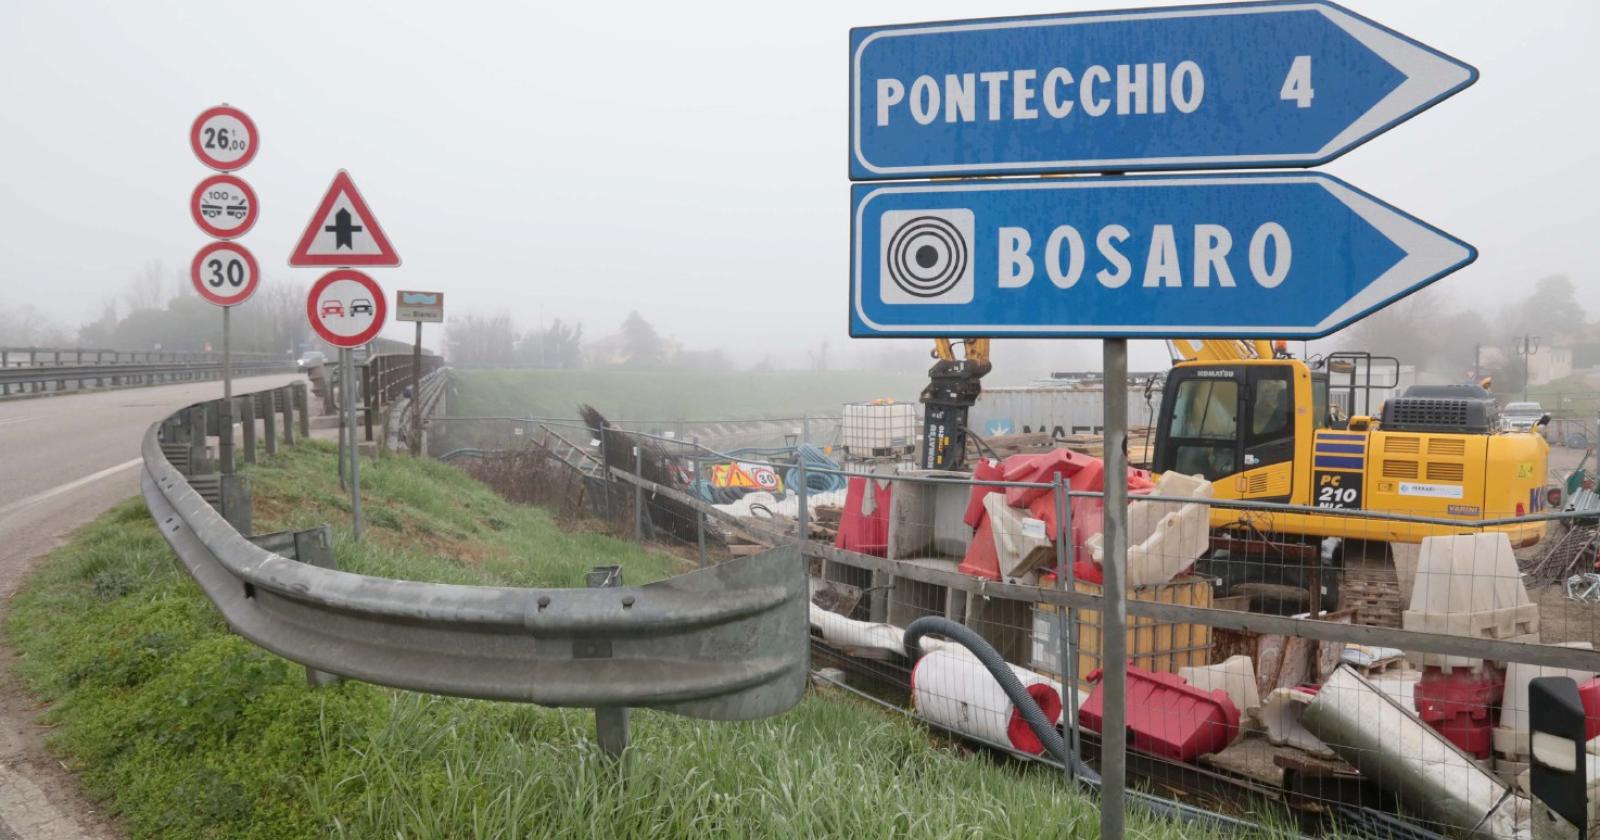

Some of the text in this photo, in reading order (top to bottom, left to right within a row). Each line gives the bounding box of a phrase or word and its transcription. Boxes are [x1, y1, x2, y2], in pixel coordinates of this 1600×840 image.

[876, 55, 1315, 126] PONTECCHIO 4
[208, 191, 229, 200] 100
[998, 221, 1293, 289] BOSARO
[207, 258, 244, 287] 30
[1197, 369, 1234, 377] KOMATSU
[927, 424, 937, 469] KOMATSU
[759, 473, 774, 484] 30
[1320, 474, 1342, 487] PC
[1318, 486, 1358, 503] 210
